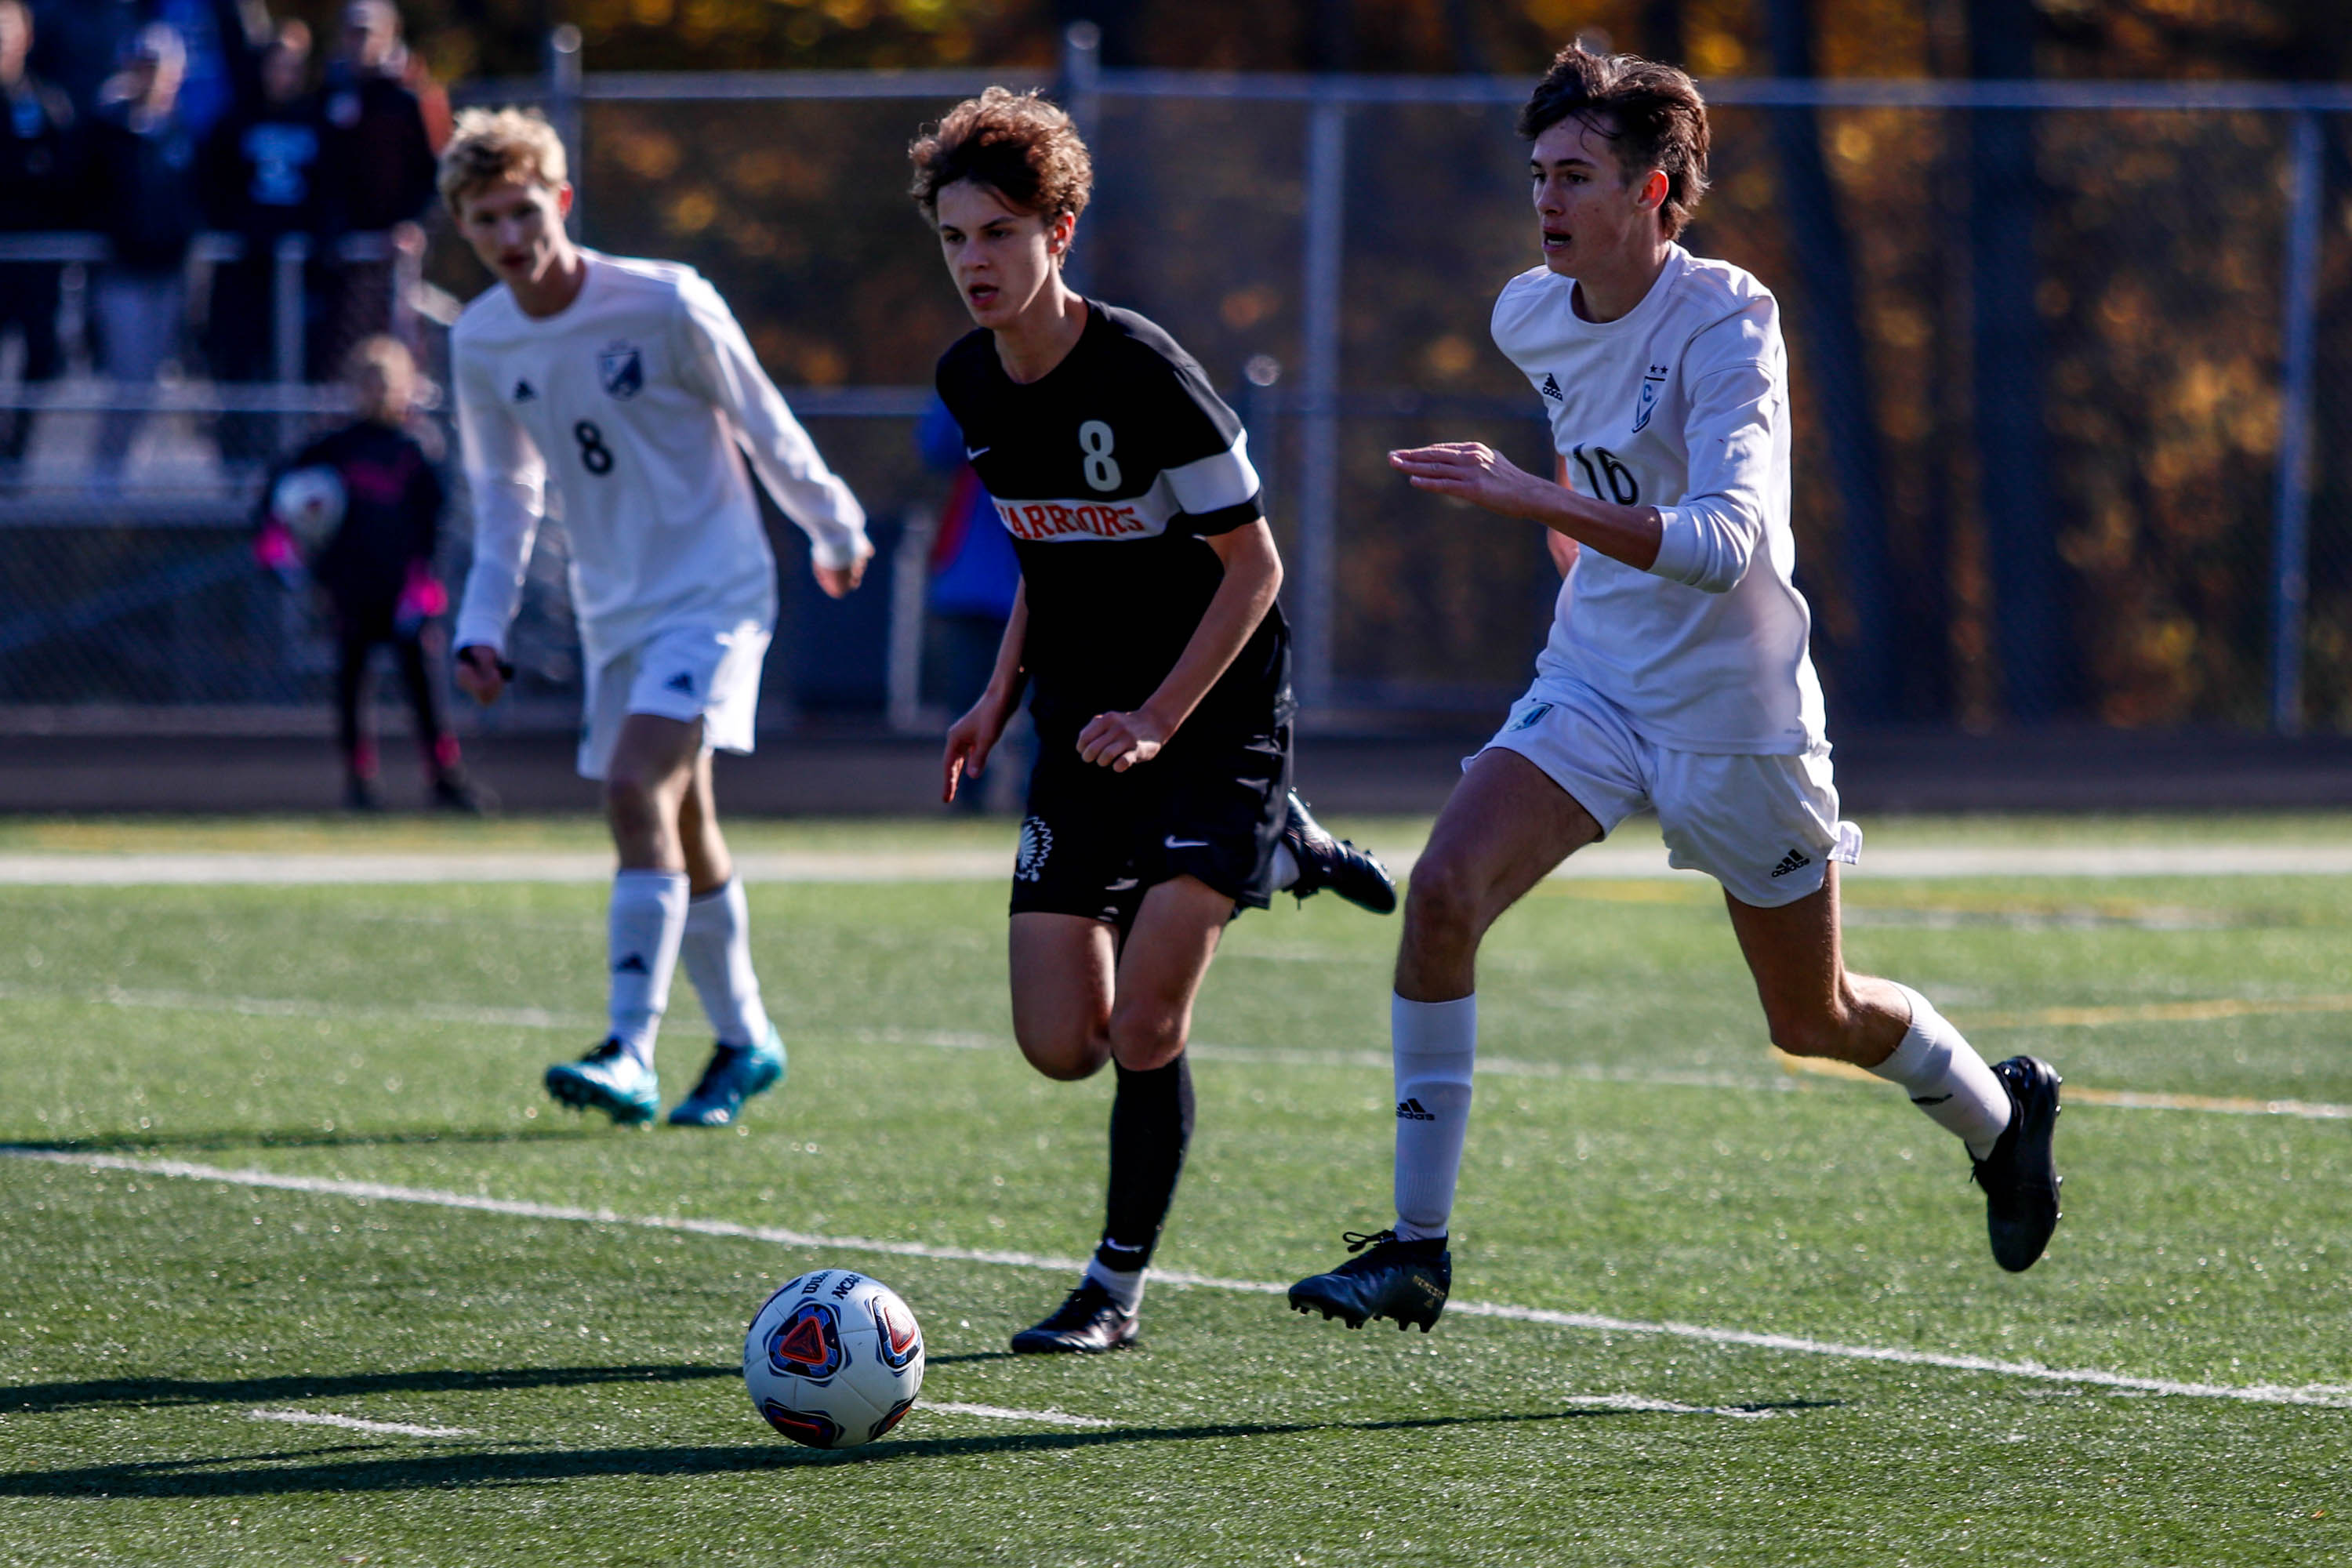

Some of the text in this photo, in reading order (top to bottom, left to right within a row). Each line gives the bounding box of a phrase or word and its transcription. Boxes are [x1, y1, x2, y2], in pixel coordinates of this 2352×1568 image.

[574, 419, 614, 476] 8
[1079, 419, 1122, 492] 8
[1573, 443, 1639, 508] 16
[994, 505, 1145, 539] ARRIORS
[1771, 858, 1810, 878] adidas
[831, 1273, 863, 1300] NCAA
